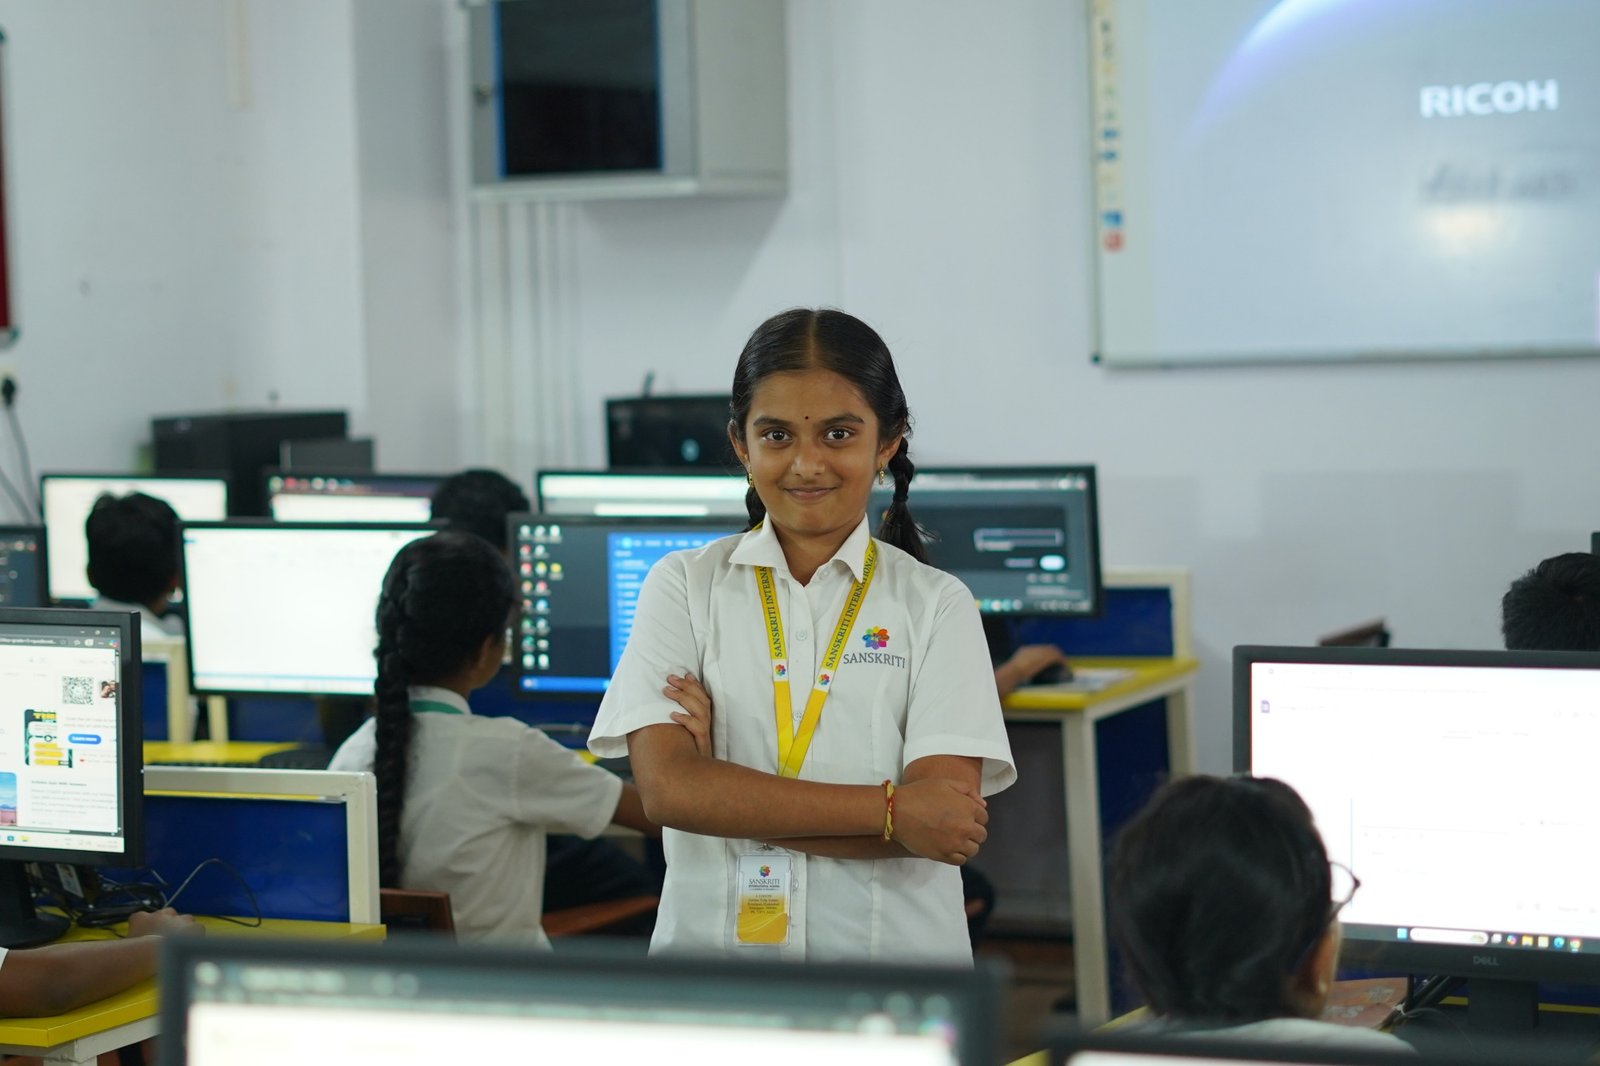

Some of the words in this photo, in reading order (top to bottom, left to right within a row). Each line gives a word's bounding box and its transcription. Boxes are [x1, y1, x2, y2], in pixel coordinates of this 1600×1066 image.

[1420, 78, 1558, 118] RICOH
[760, 566, 774, 604] INTERNA
[768, 606, 783, 658] SANSKRITI
[826, 618, 850, 668] SANSKRITI
[843, 652, 906, 669] SANSKRITI
[1472, 955, 1500, 966] DELL
